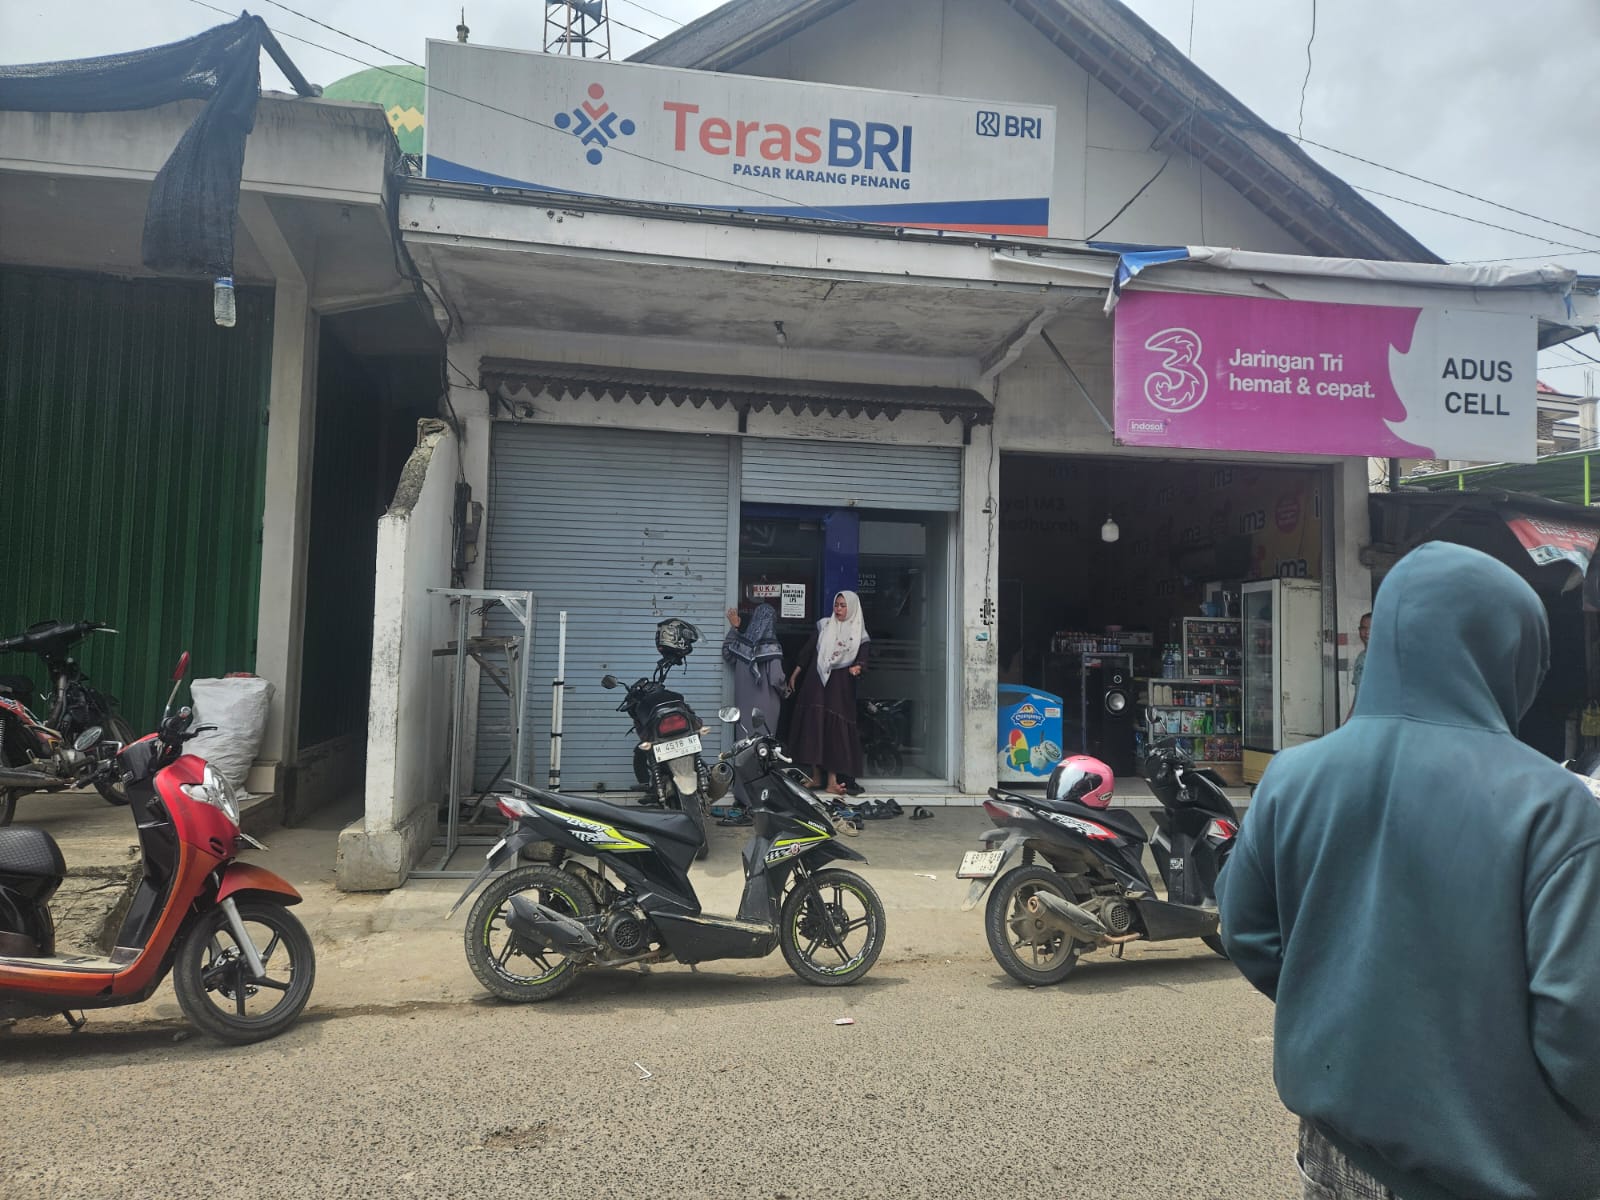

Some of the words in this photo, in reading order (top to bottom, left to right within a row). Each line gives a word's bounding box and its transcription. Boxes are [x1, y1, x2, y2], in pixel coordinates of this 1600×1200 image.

[663, 101, 913, 173] TerasBRI
[1005, 115, 1042, 139] BRI
[733, 163, 782, 179] PASAR
[785, 168, 847, 185] KARANG
[851, 174, 911, 190] PENANG
[1229, 349, 1314, 373] Jaringan
[1319, 353, 1344, 372] Tri
[1442, 357, 1513, 383] ADUS
[1229, 373, 1292, 394] hemat
[1296, 377, 1311, 395] &
[1316, 381, 1376, 400] cepat.
[1445, 391, 1510, 416] CELL
